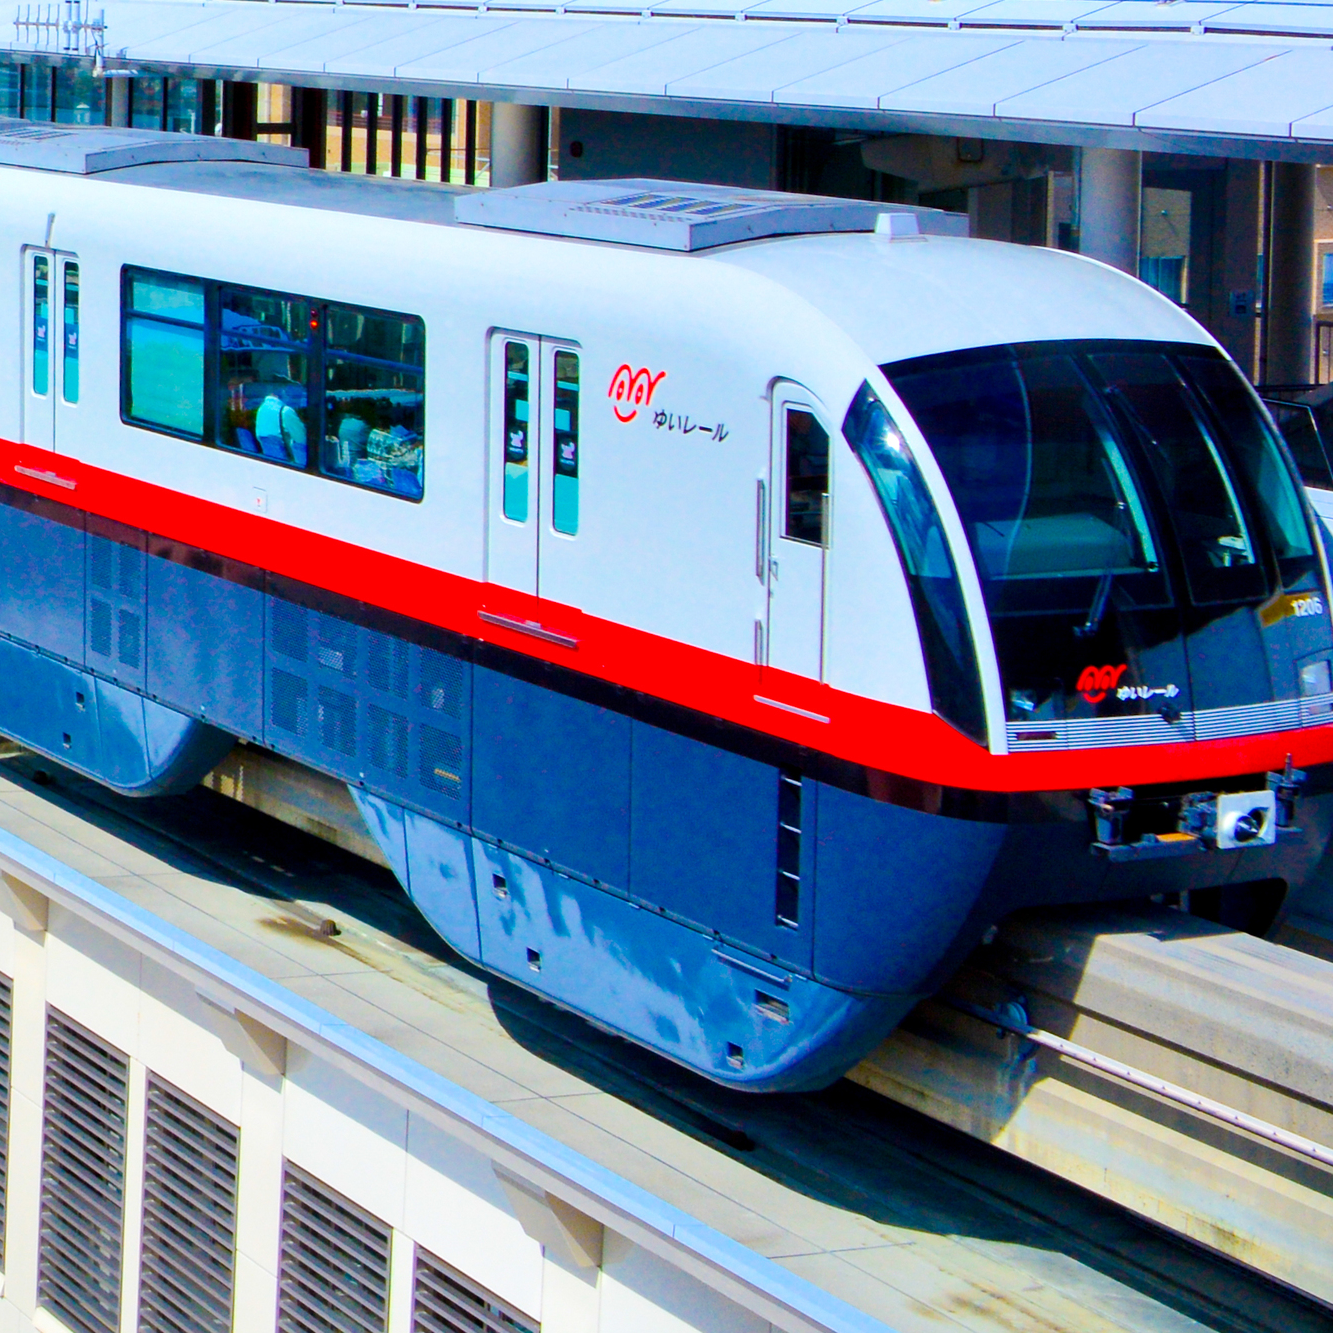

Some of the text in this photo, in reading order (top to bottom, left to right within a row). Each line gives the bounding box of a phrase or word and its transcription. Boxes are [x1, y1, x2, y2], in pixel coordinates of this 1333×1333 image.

[652, 408, 729, 442] ゆいレール
[1290, 597, 1323, 617] 1206
[1116, 685, 1180, 701] ゆいレール
